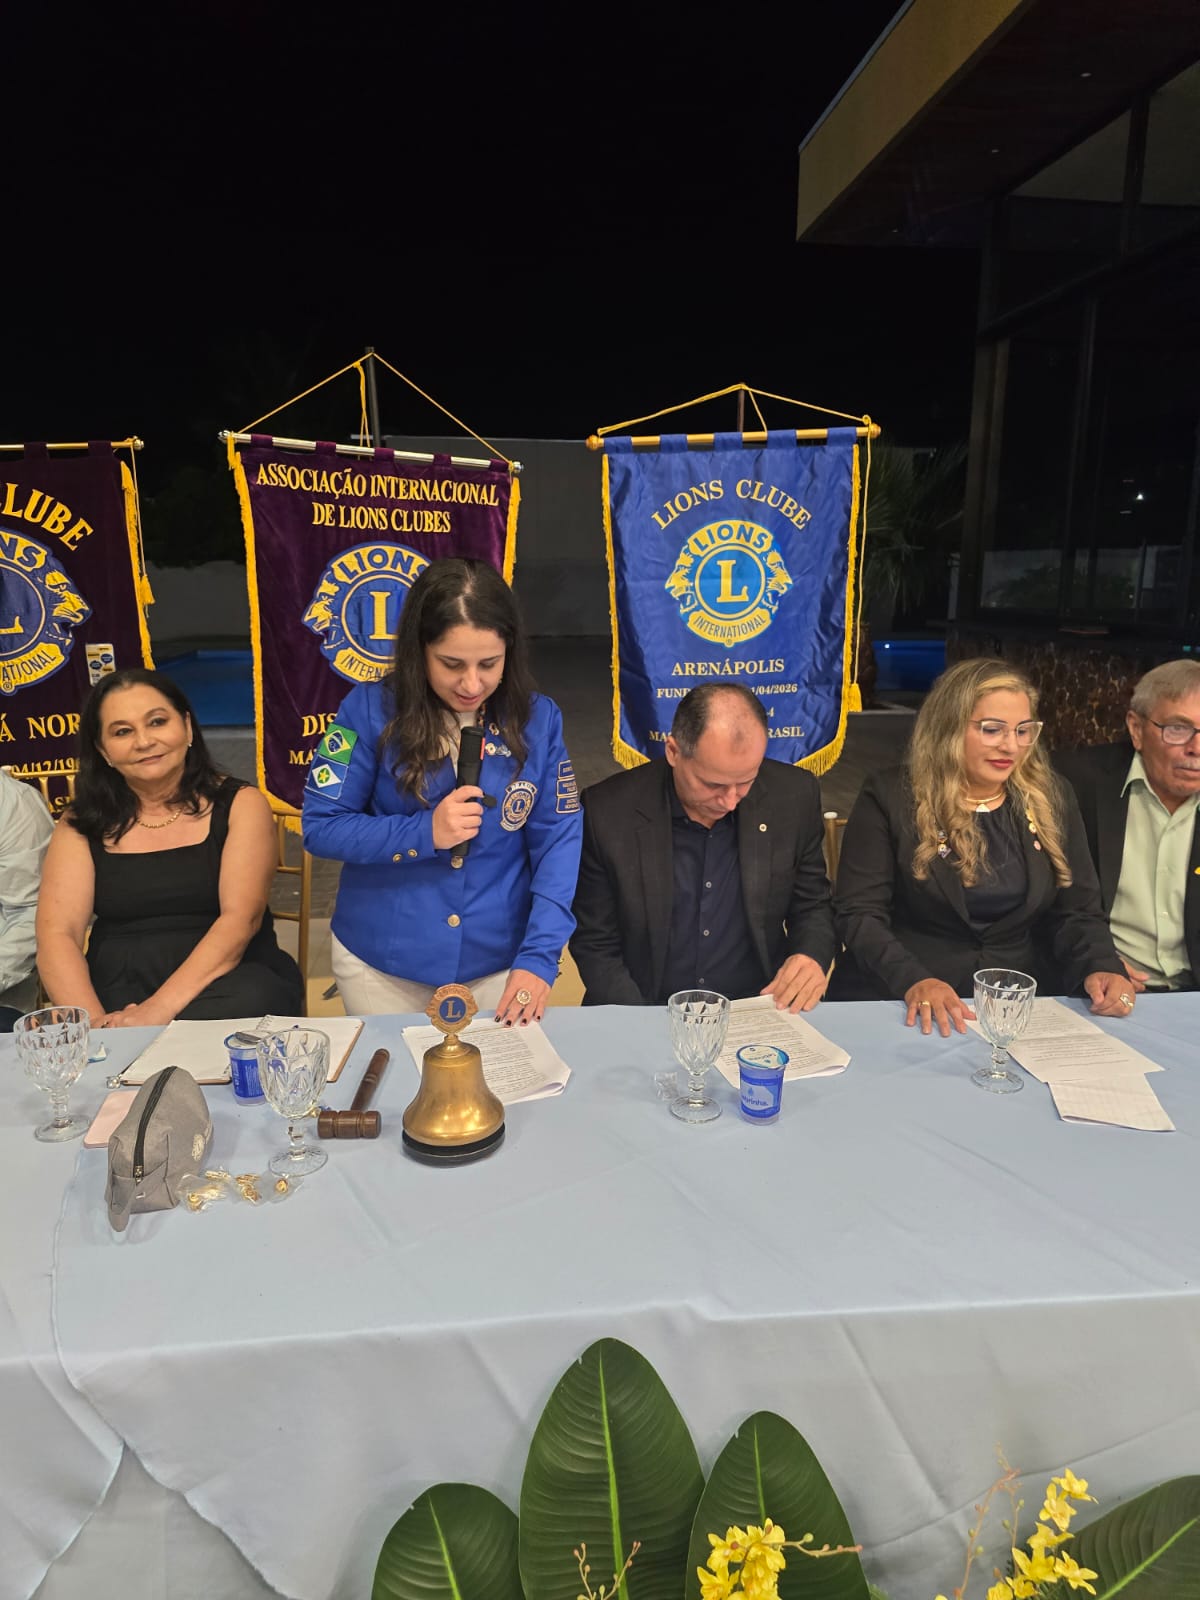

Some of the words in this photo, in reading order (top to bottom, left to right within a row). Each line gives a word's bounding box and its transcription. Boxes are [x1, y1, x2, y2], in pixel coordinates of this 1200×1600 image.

[256, 463, 367, 500] ASSOCIAÇÃO
[370, 474, 499, 506] INTERNACIONAL
[0, 482, 94, 551] LUBE
[312, 502, 336, 526] DE
[338, 505, 388, 530] LIONS
[391, 508, 451, 532] CLUBES
[652, 479, 724, 530] LIONS
[735, 479, 812, 530] CLUBE
[693, 524, 768, 550] LIONS
[716, 560, 749, 603] L
[693, 614, 766, 638] INTERNATIONAL
[671, 658, 785, 676] ARENÁPOLIS
[445, 1000, 461, 1018] L
